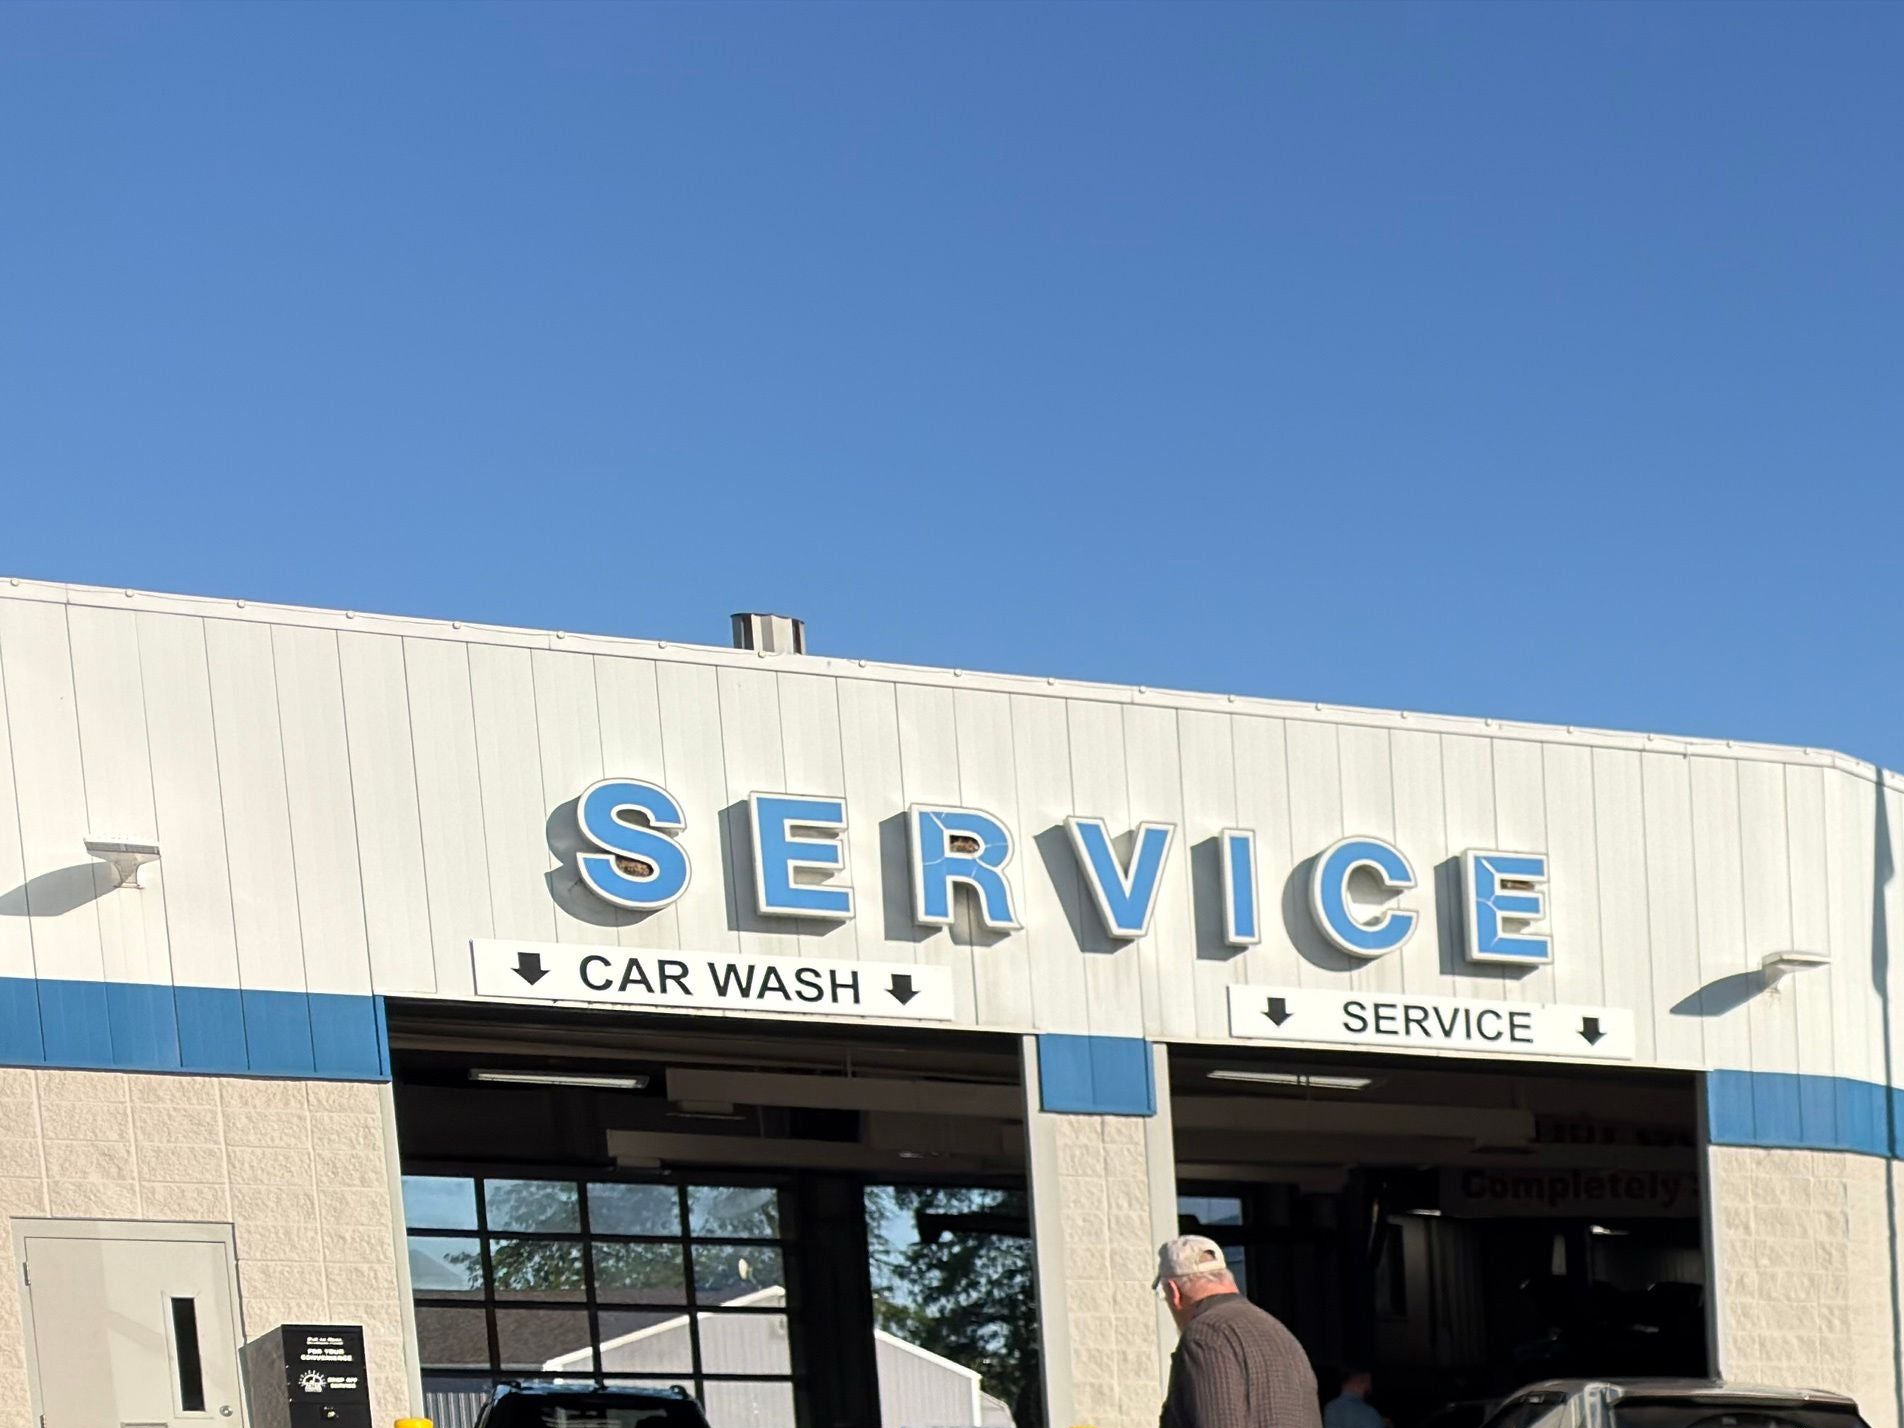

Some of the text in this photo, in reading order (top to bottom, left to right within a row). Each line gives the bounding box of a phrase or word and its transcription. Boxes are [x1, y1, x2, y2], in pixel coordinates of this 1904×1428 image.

[576, 777, 1553, 967] SERVICE
[579, 954, 861, 1005] CAR WASH
[1342, 1001, 1535, 1044] SERVICE
